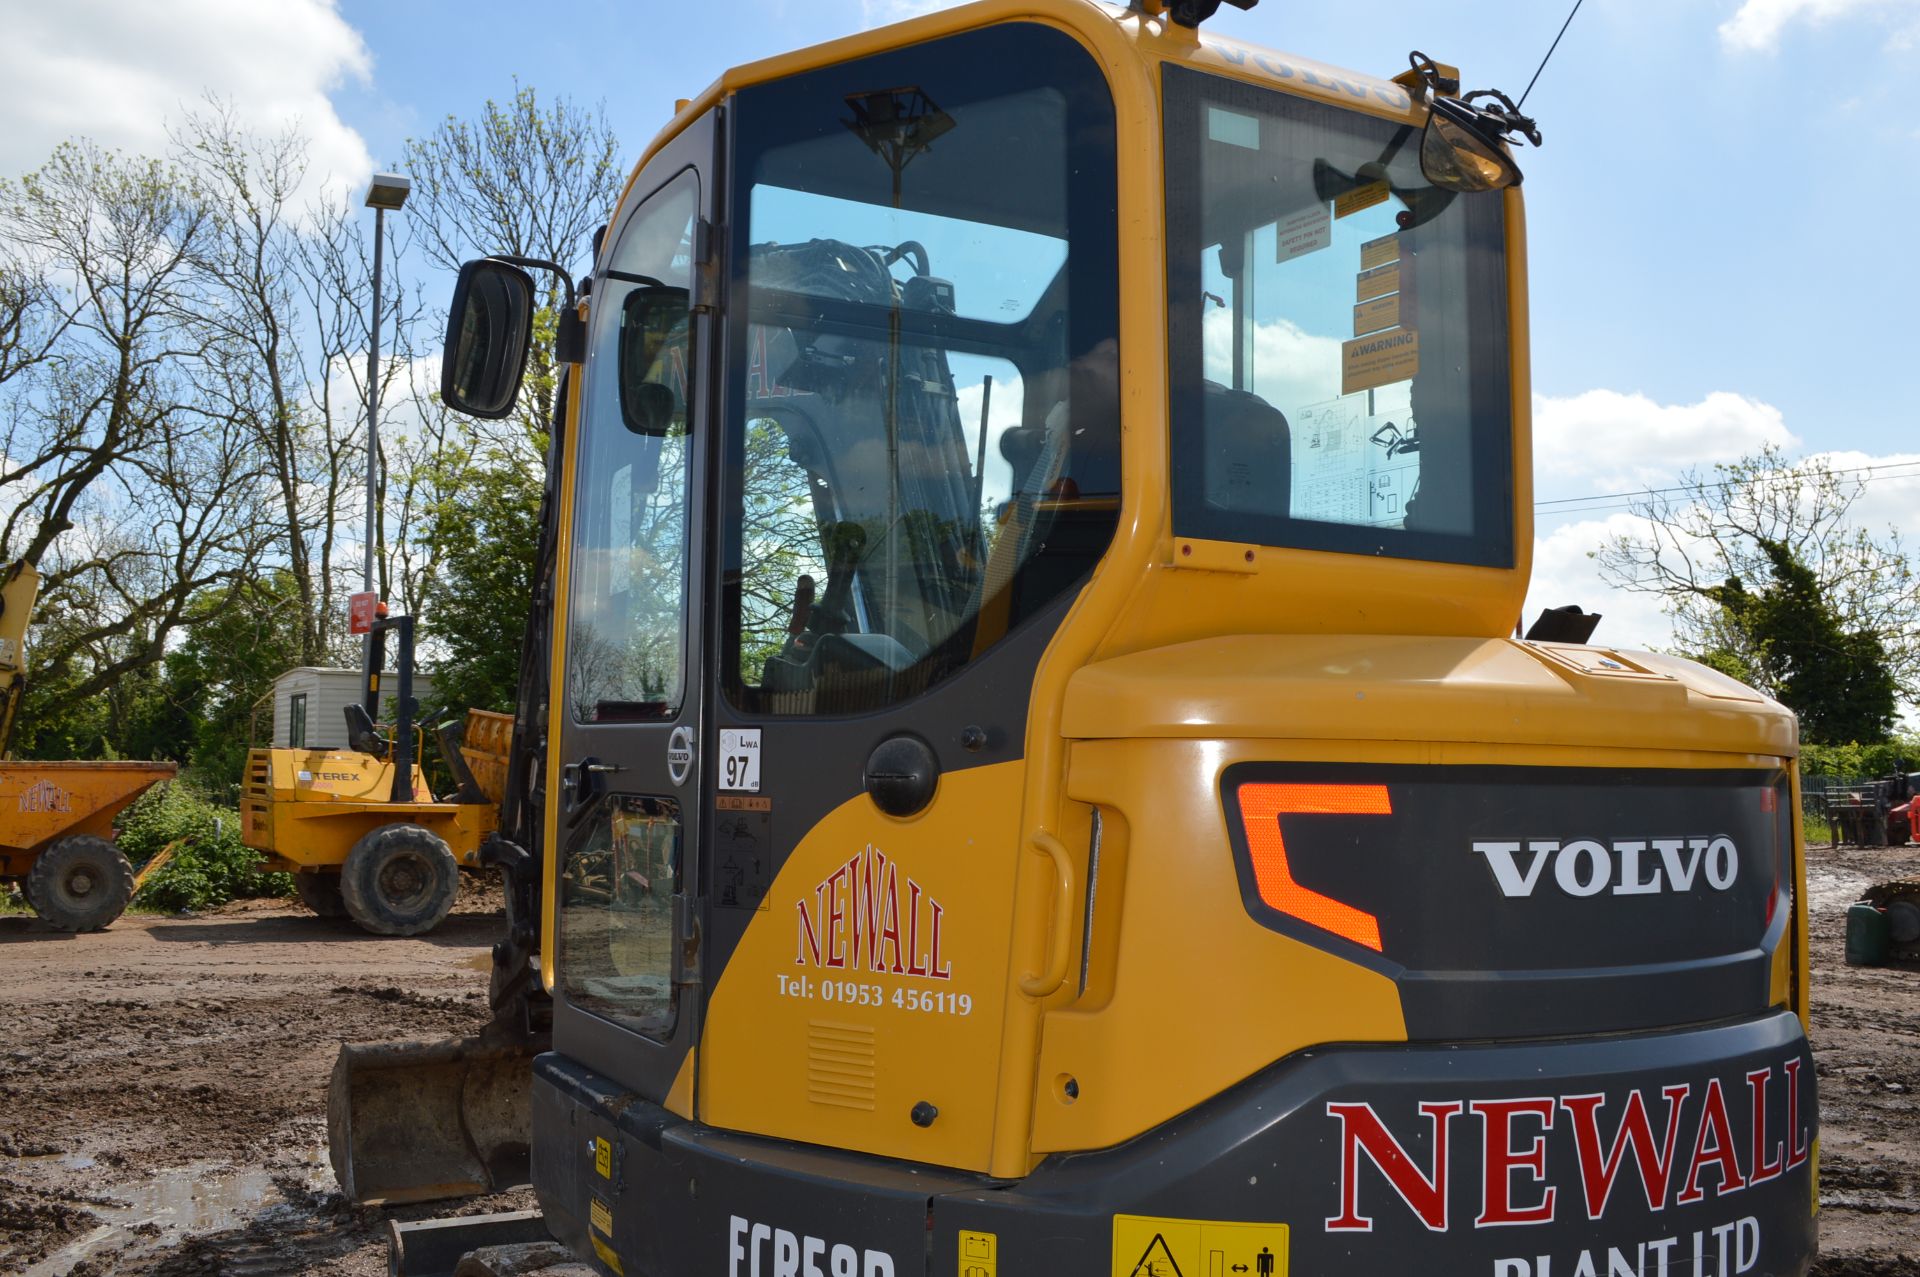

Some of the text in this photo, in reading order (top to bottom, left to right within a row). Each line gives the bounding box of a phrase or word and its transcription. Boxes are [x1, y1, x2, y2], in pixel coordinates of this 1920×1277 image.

[1209, 43, 1411, 110] VOLVO
[1359, 333, 1413, 355] WARNING
[315, 771, 361, 782] TEREX
[726, 755, 749, 788] 97
[1472, 837, 1739, 897] VOLVO
[795, 843, 952, 981] NEWALL
[777, 974, 973, 1016] Tel: 01953 456119
[1324, 1056, 1809, 1233] NEWALL
[1494, 1215, 1761, 1277] ANT LTD
